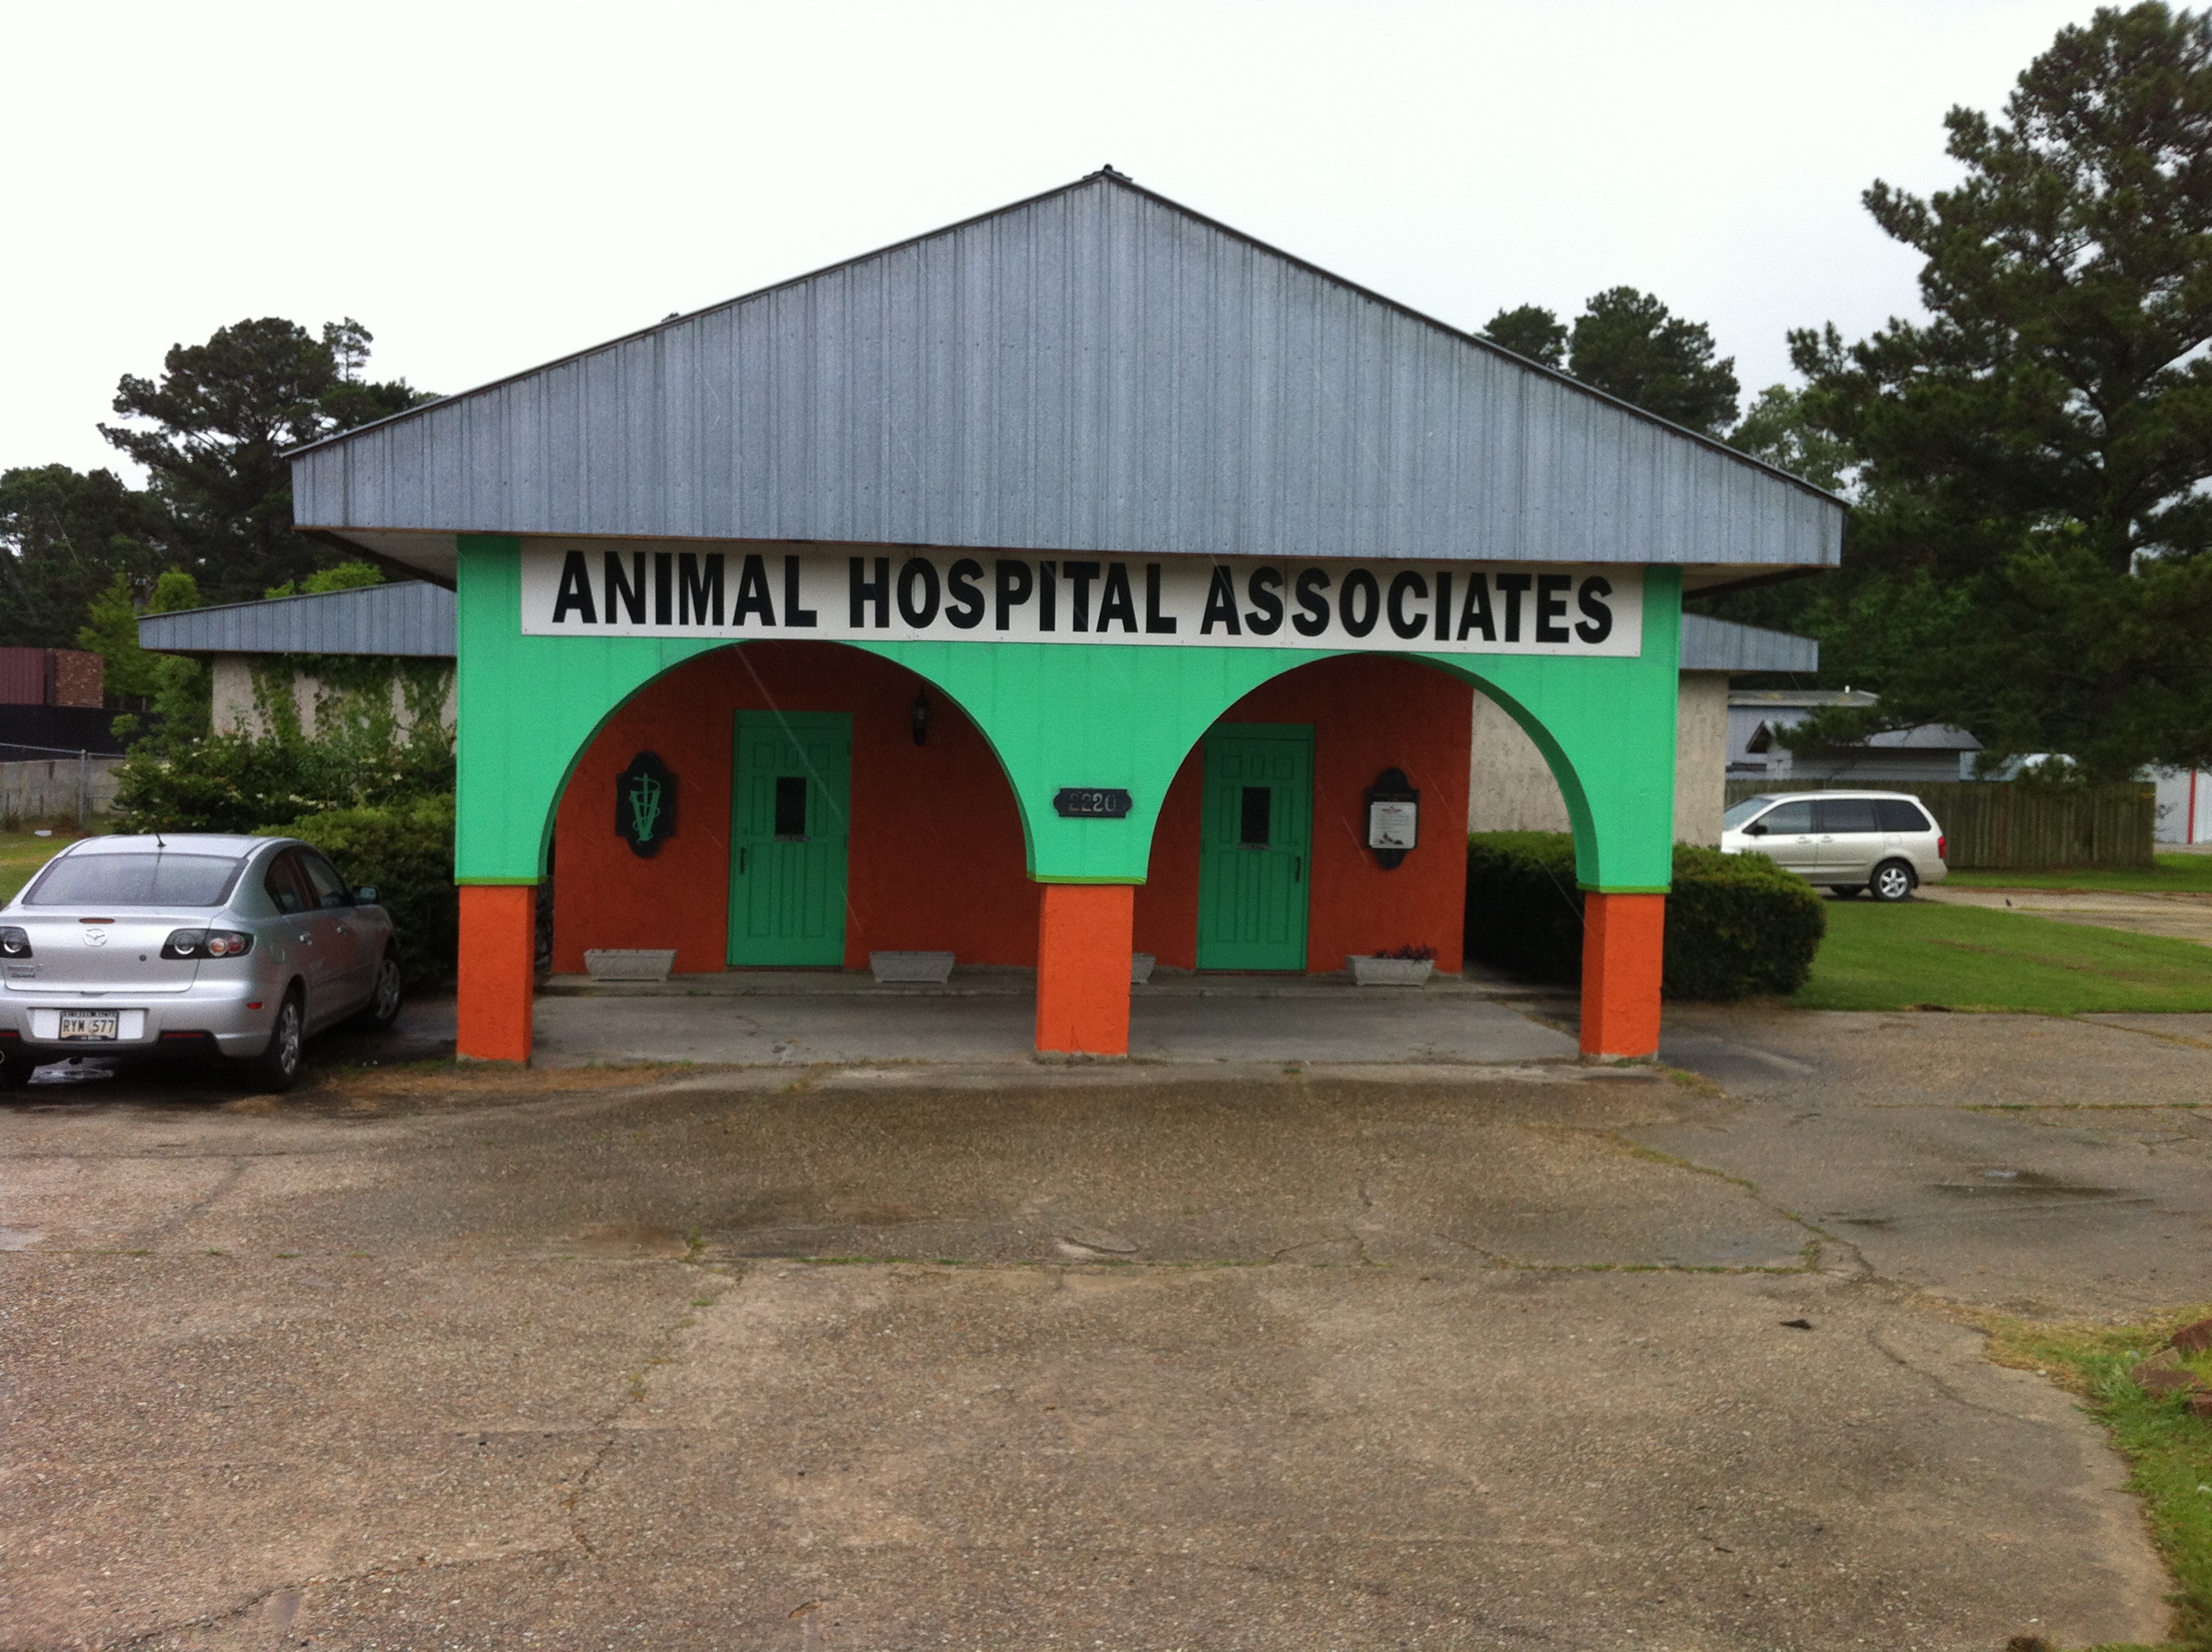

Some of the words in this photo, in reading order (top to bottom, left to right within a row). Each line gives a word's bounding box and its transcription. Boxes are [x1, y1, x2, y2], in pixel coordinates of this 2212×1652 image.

[552, 550, 818, 627] ANIMAL
[849, 556, 1177, 634] HOSPITAL
[1200, 564, 1613, 643] ASSOCIATES
